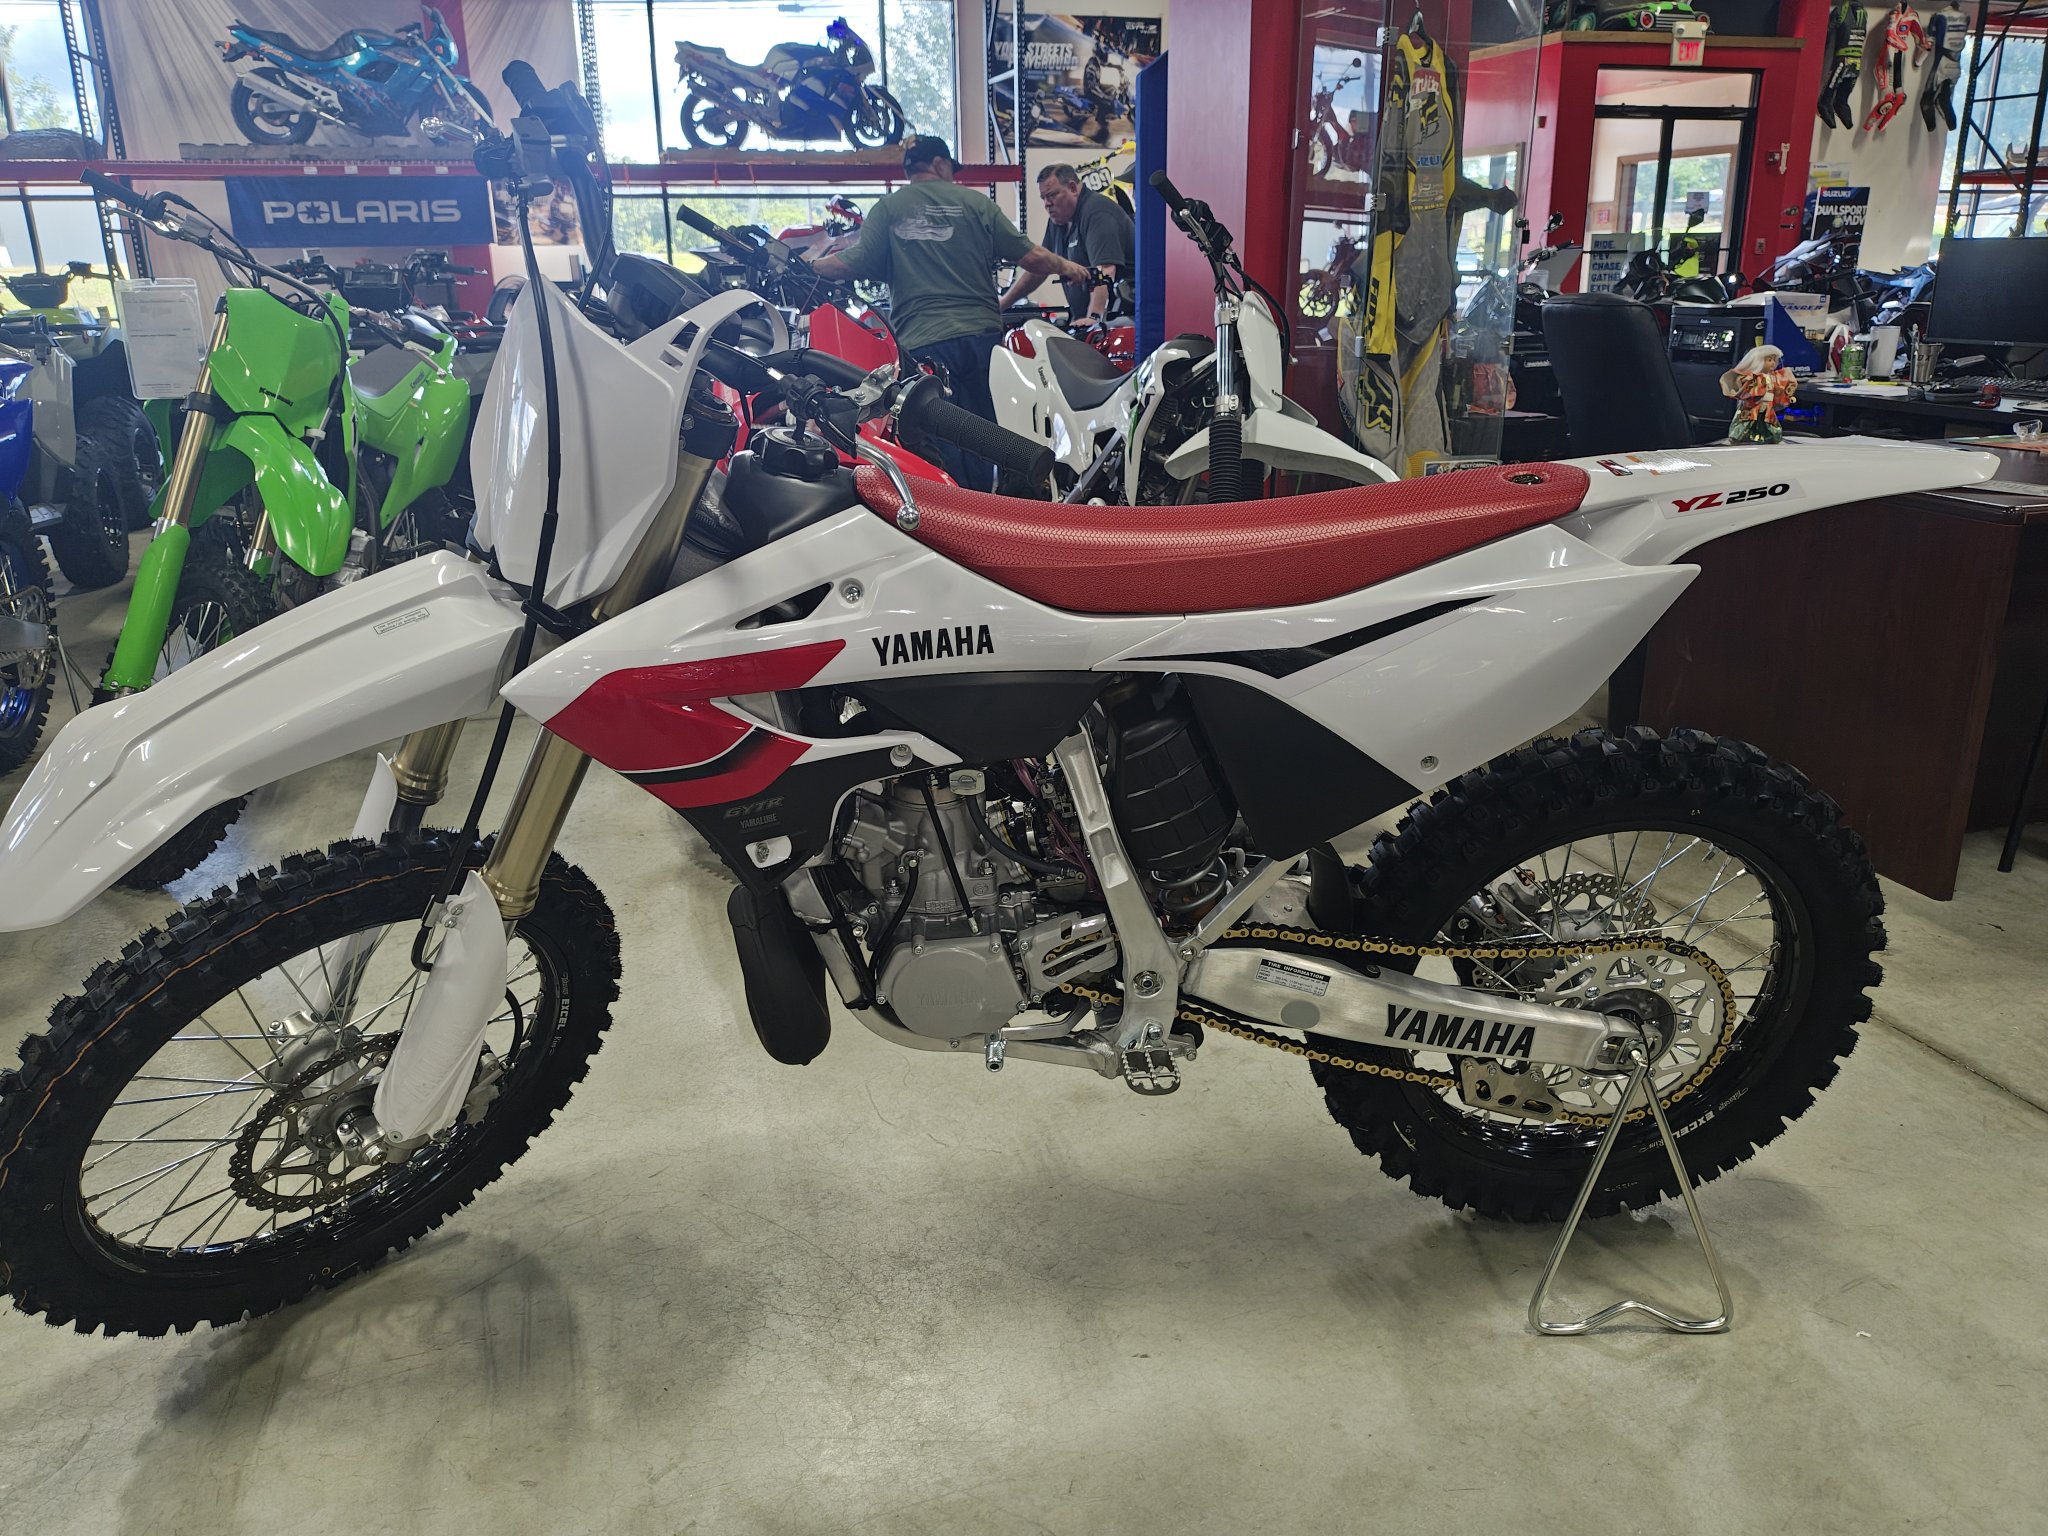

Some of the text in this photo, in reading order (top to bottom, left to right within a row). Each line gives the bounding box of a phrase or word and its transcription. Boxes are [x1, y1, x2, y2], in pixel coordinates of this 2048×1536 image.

[1027, 42, 1073, 57] STREETS
[1679, 41, 1700, 62] EXIT
[1822, 190, 1851, 198] SUZUKI
[262, 199, 462, 225] POLARIS
[1591, 273, 1621, 282] GATHE
[1366, 277, 1380, 337] FOX
[1671, 483, 1790, 513] YZ250
[871, 624, 995, 667] YAMAHA
[723, 795, 785, 819] GYTR
[740, 813, 778, 829] YAMALUBE
[1267, 961, 1324, 980] TIRE INFORMATION
[557, 999, 570, 1030] EXCEL
[1384, 1003, 1536, 1059] YAMAHA
[1671, 1110, 1716, 1139] EXCEL
